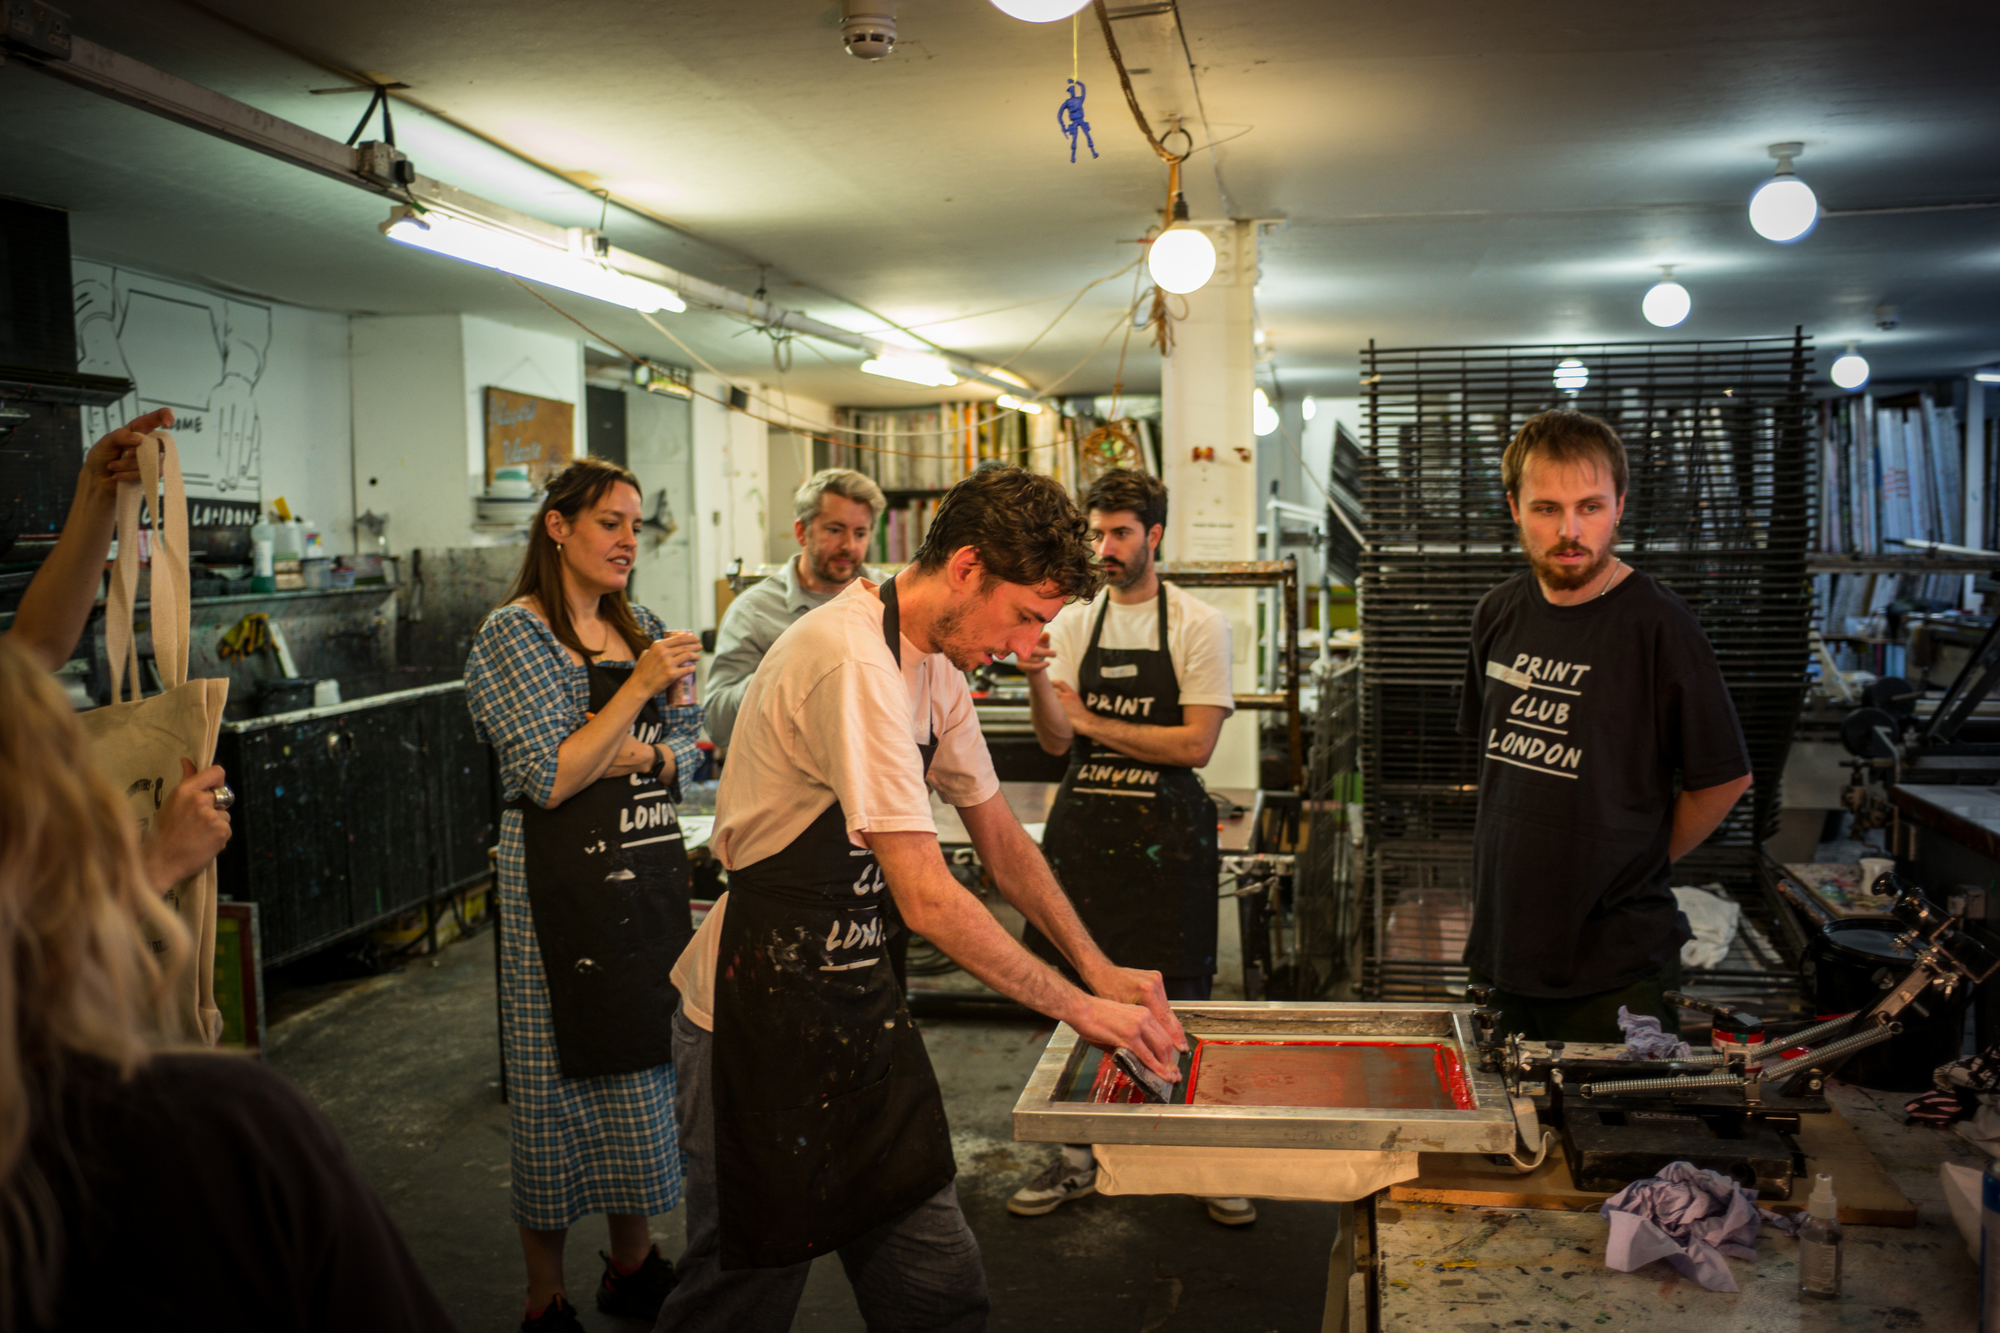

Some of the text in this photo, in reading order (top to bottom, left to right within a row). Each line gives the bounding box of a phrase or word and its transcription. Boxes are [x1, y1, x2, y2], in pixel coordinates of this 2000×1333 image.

[192, 503, 257, 527] LONDON
[1511, 653, 1592, 686] PRINT
[1086, 692, 1155, 717] PRINT
[1510, 694, 1571, 725] CLUB
[1487, 728, 1582, 769] LONDON
[853, 863, 887, 896] CL
